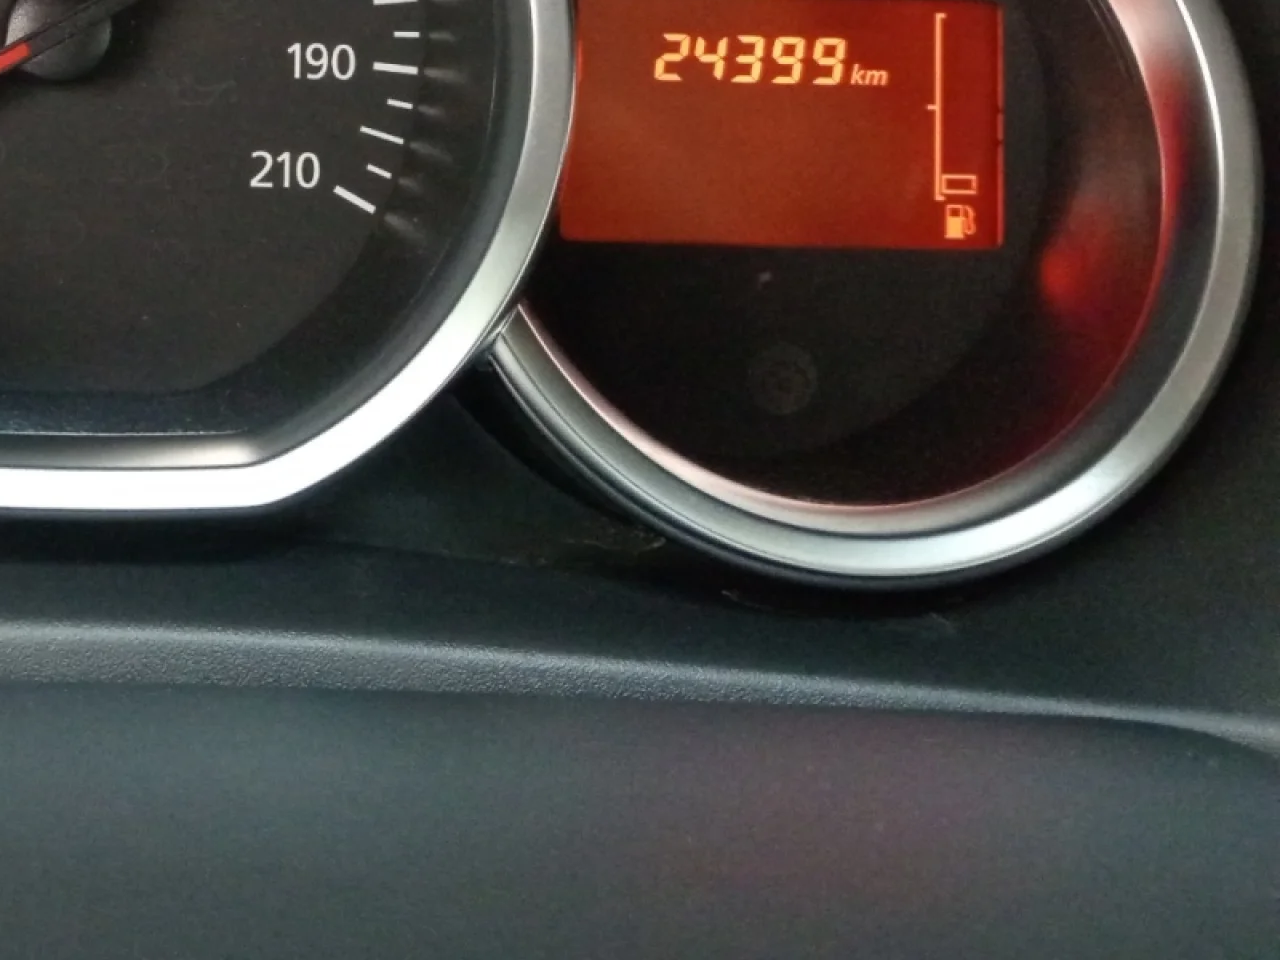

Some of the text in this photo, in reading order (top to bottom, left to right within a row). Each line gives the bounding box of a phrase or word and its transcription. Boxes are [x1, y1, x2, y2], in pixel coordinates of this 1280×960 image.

[287, 42, 356, 81] 190
[654, 33, 889, 86] 24399 km
[250, 150, 321, 189] 210
